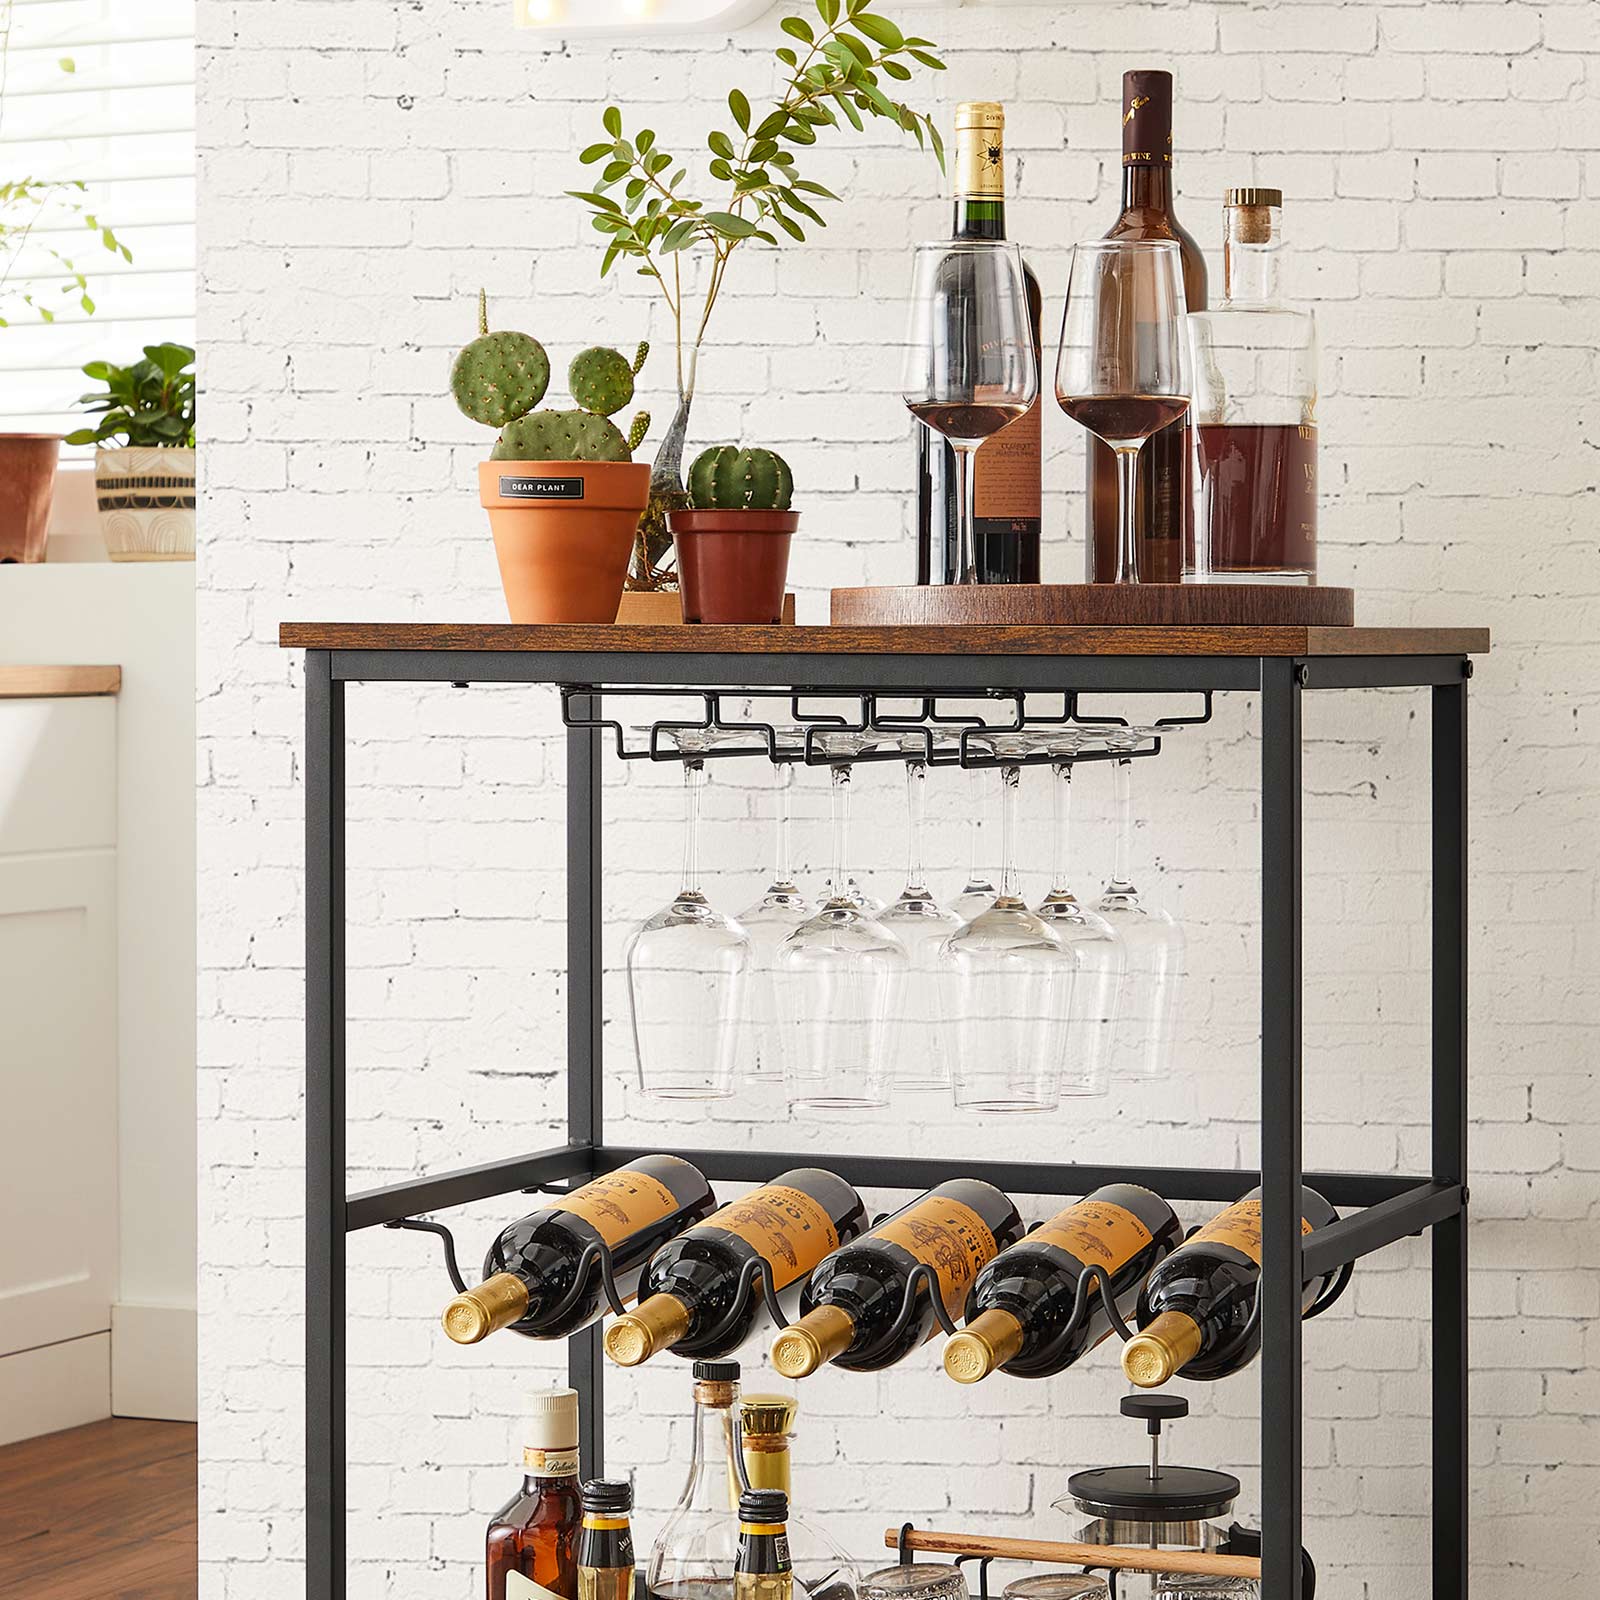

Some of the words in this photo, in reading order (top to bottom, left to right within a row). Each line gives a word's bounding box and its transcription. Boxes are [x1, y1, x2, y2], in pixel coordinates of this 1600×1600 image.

[1130, 152, 1151, 161] WINE
[512, 483, 534, 491] DEAR
[536, 484, 566, 492] PLANT
